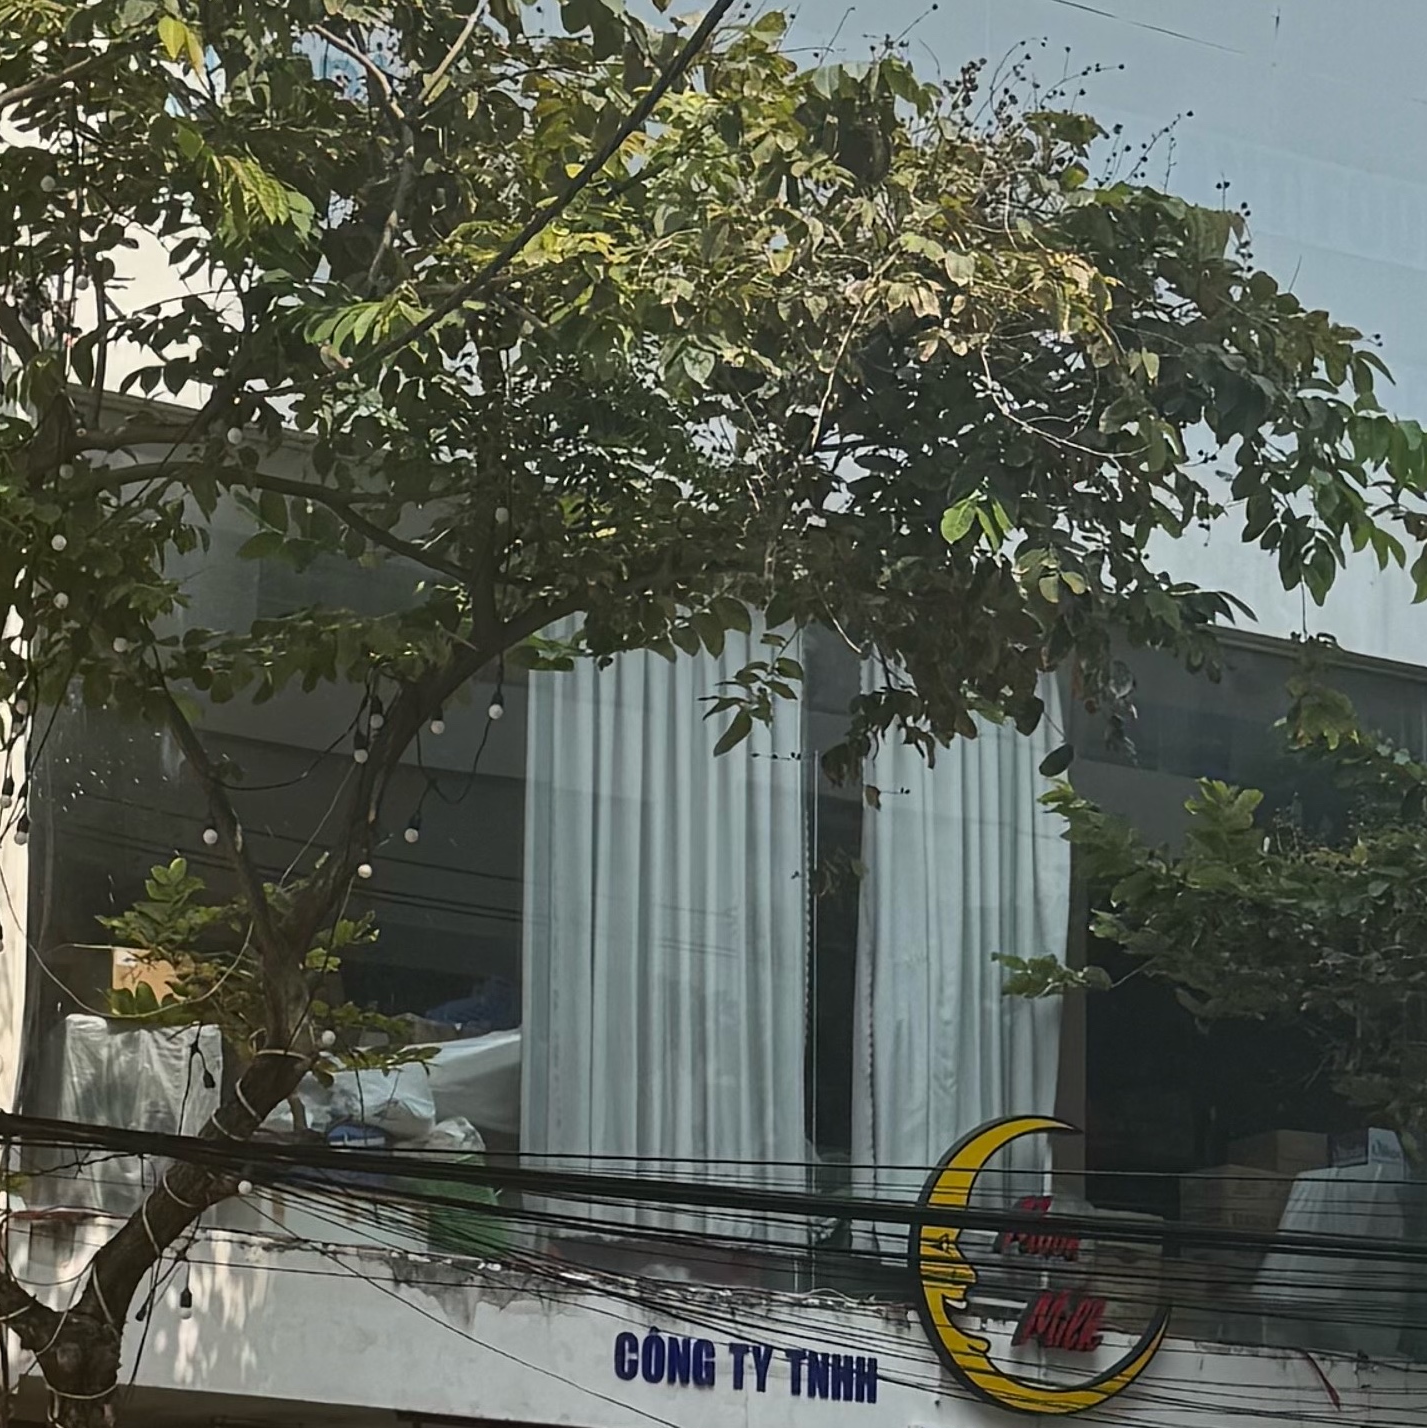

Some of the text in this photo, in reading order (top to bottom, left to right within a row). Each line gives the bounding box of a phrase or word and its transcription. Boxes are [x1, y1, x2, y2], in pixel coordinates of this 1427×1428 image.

[613, 1326, 878, 1404] CÔNG TY TNHH
